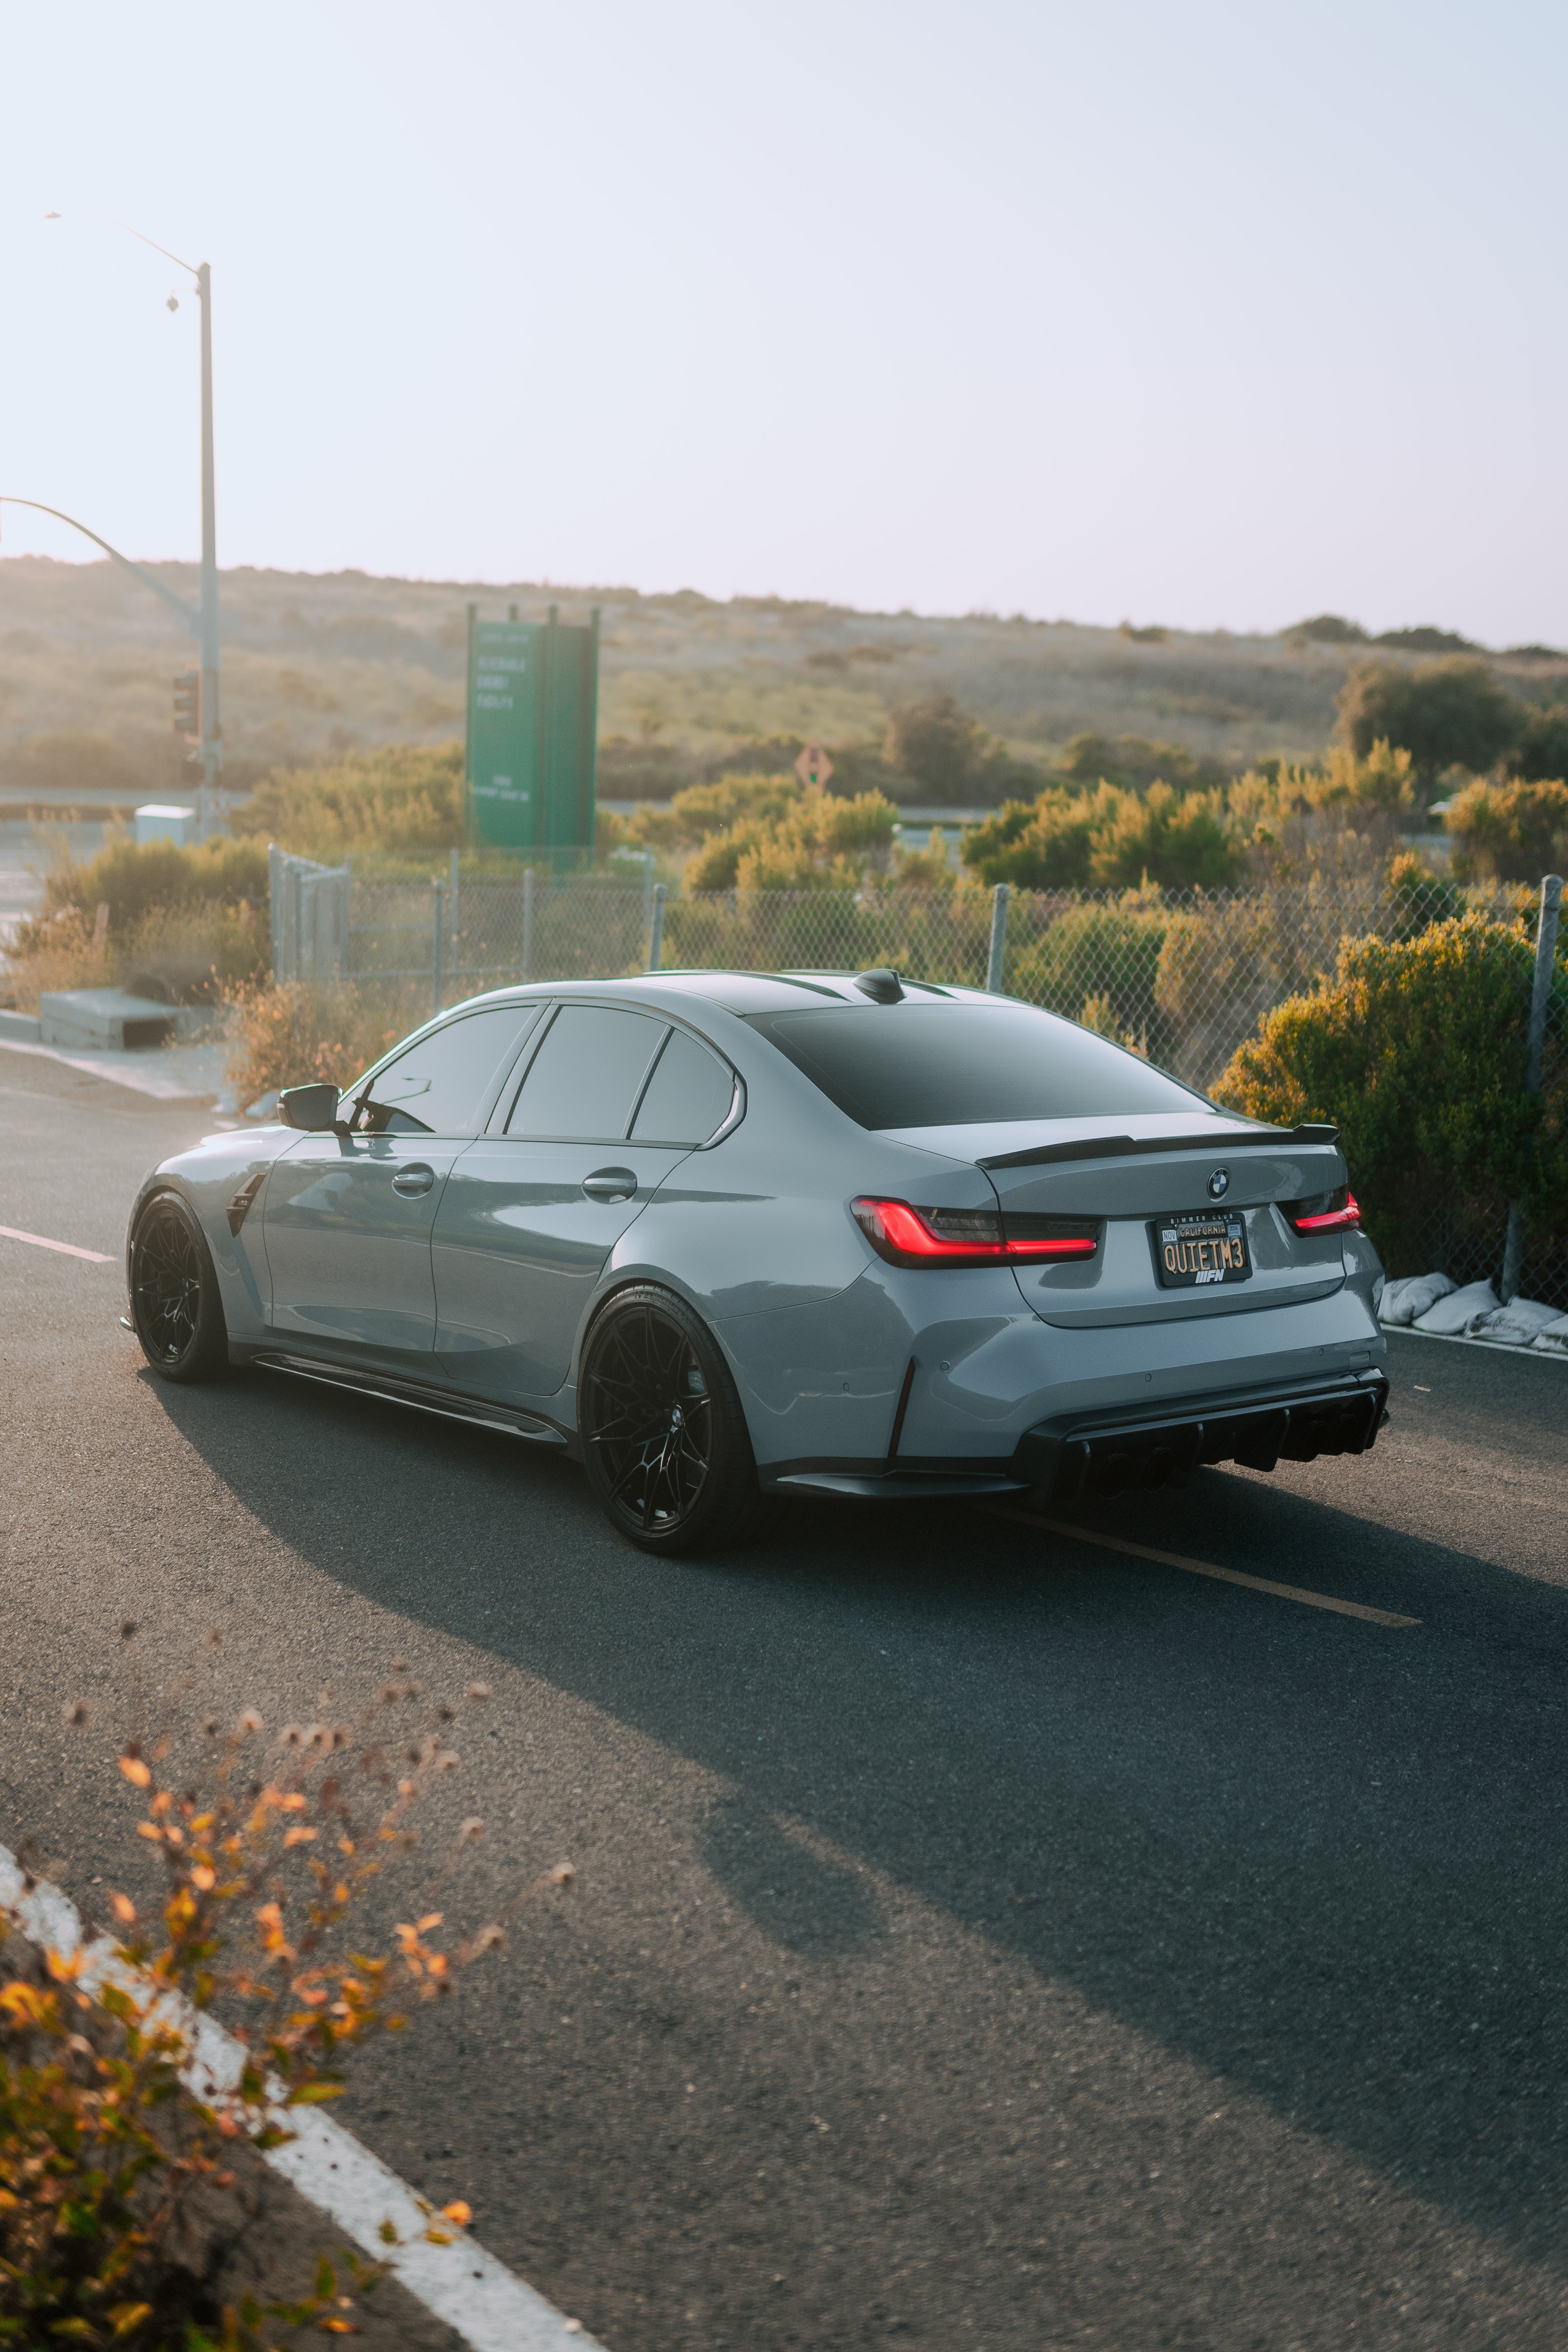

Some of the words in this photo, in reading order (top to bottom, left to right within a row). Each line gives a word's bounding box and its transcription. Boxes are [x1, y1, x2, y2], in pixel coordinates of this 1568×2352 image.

[1170, 1216, 1206, 1224] BIMMER
[1164, 1231, 1176, 1240] NOV
[1180, 1225, 1226, 1237] CALIFORNIA
[1164, 1239, 1244, 1274] QUIETM3
